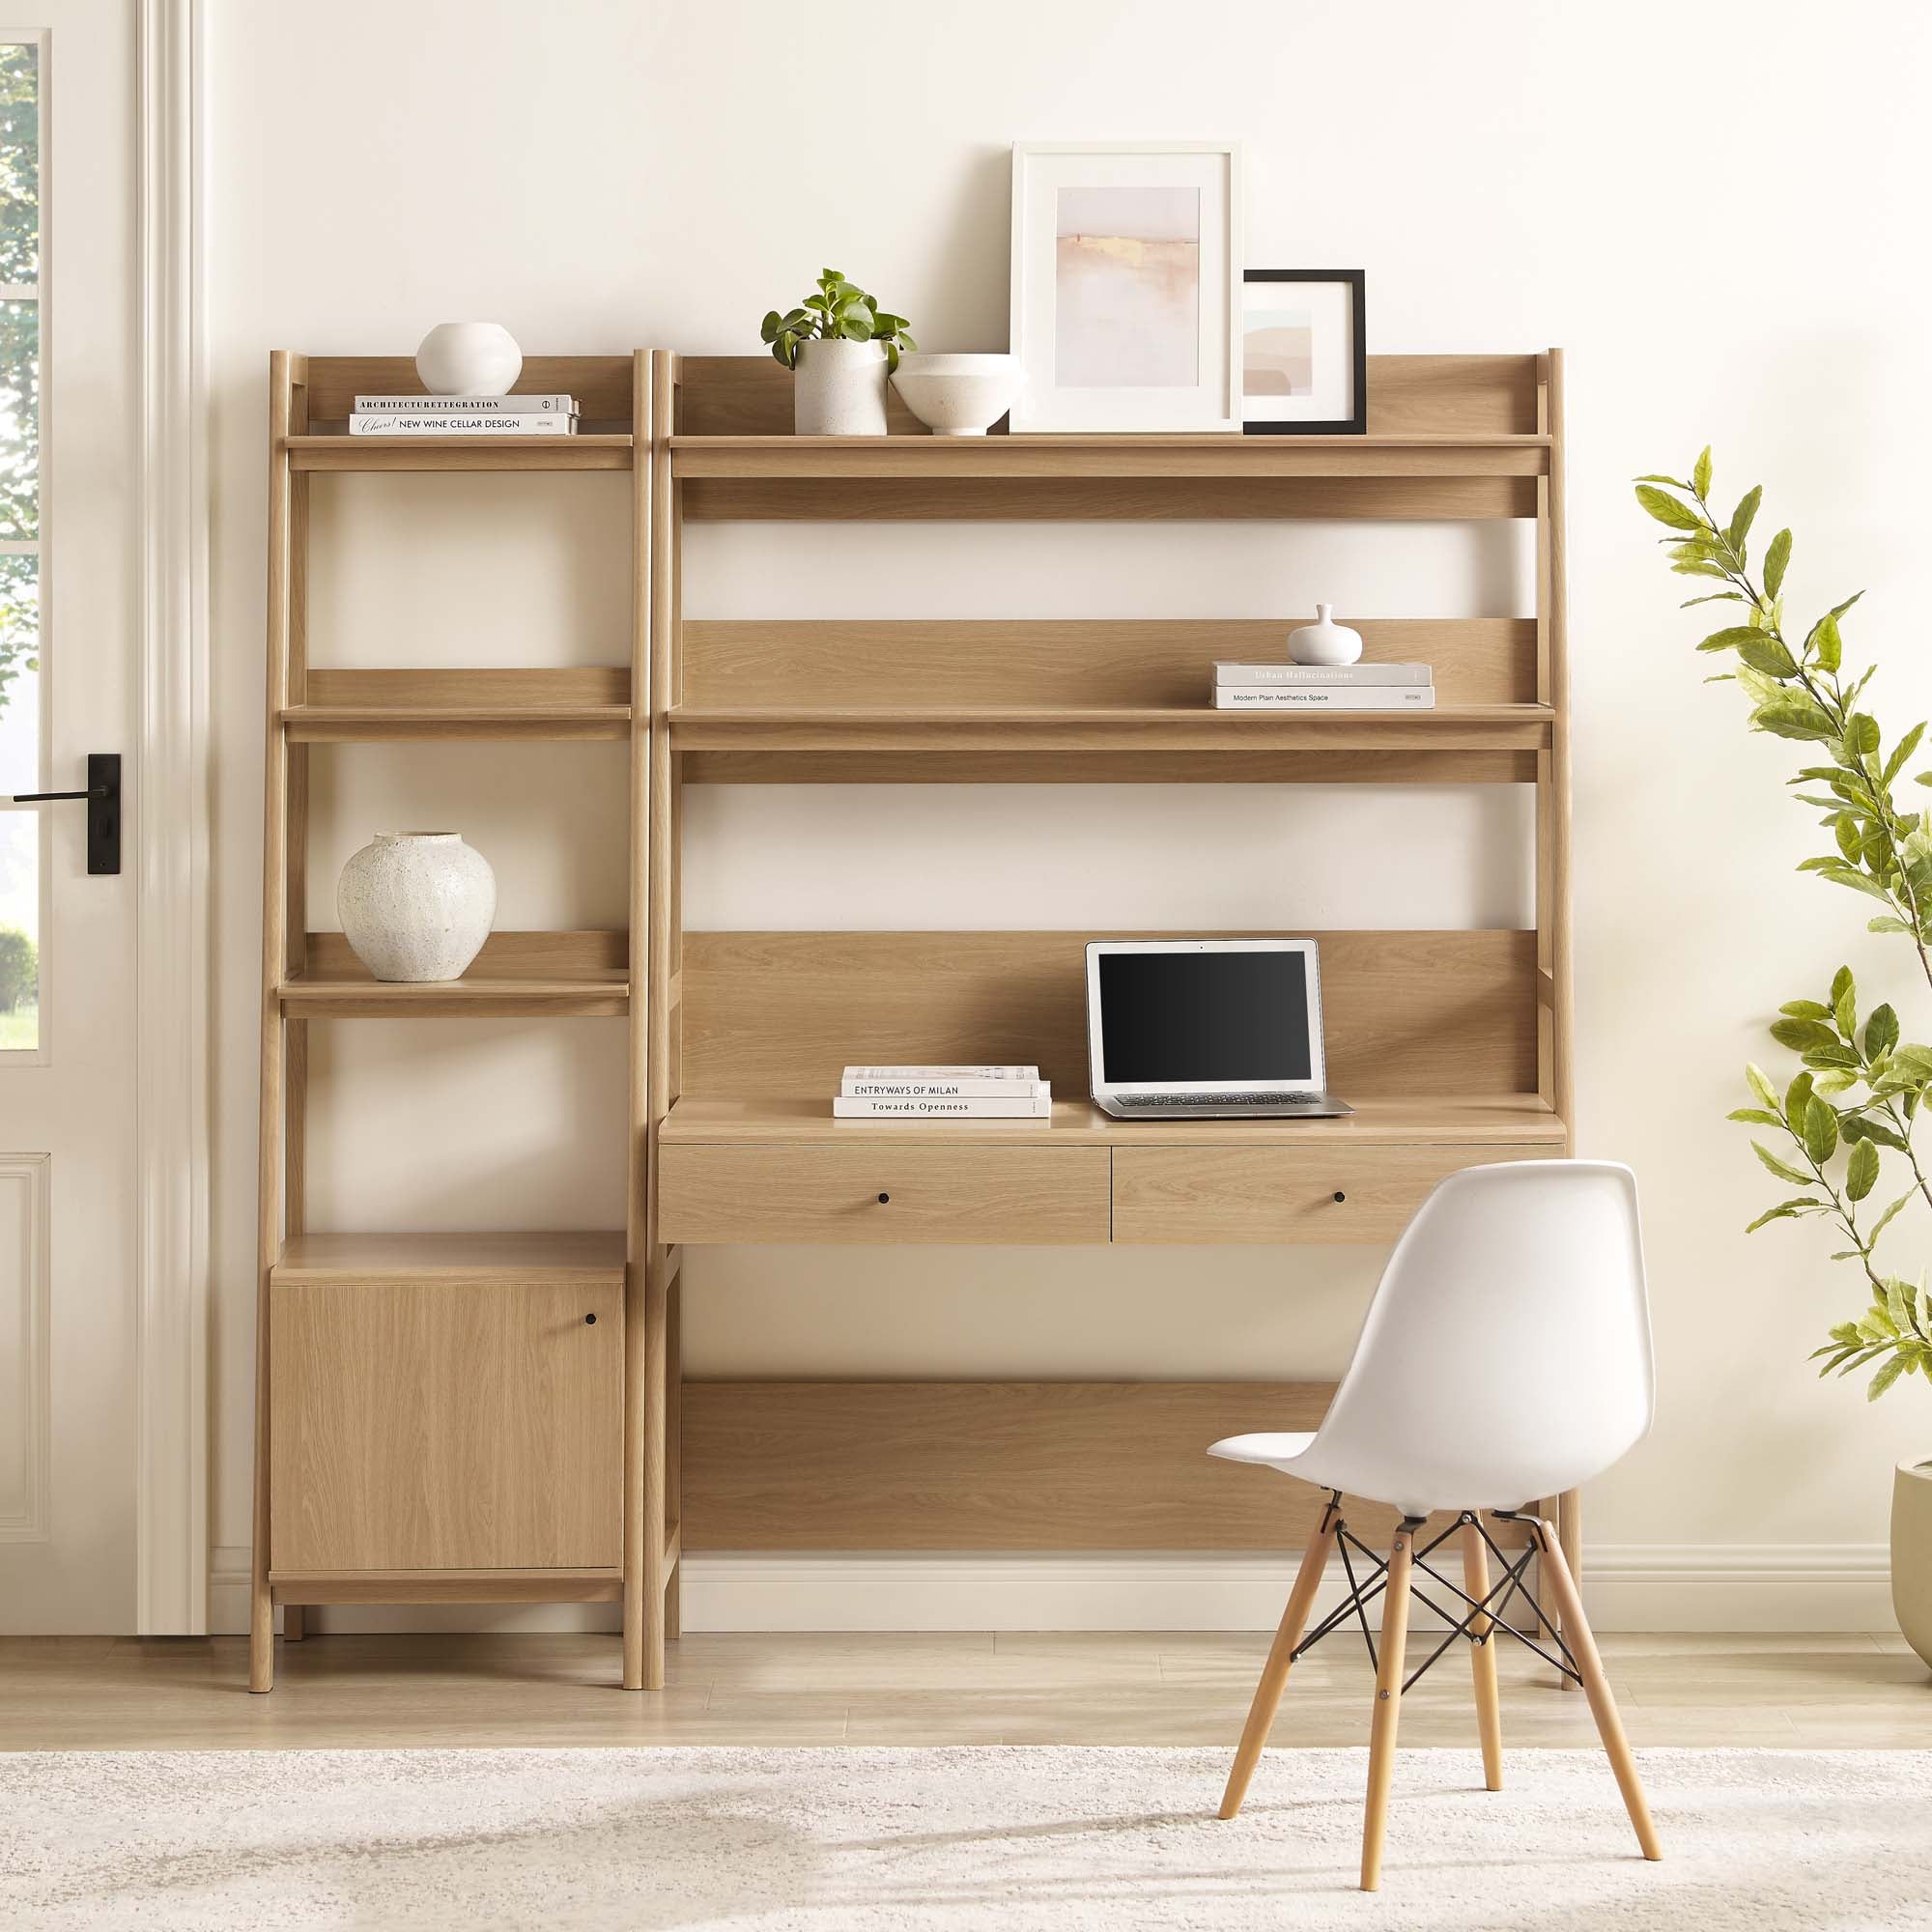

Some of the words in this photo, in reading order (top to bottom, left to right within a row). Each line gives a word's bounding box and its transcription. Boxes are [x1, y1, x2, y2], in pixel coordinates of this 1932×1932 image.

[399, 419, 421, 428] NEW
[423, 419, 447, 428] WINE
[449, 419, 483, 428] CELLAR
[485, 419, 520, 428] DESIGN
[854, 1086, 911, 1094] ENTRYWAYS
[913, 1086, 926, 1094] OF
[928, 1086, 958, 1094] MILAN
[871, 1102, 915, 1111] Towards
[919, 1102, 969, 1112] Openness
